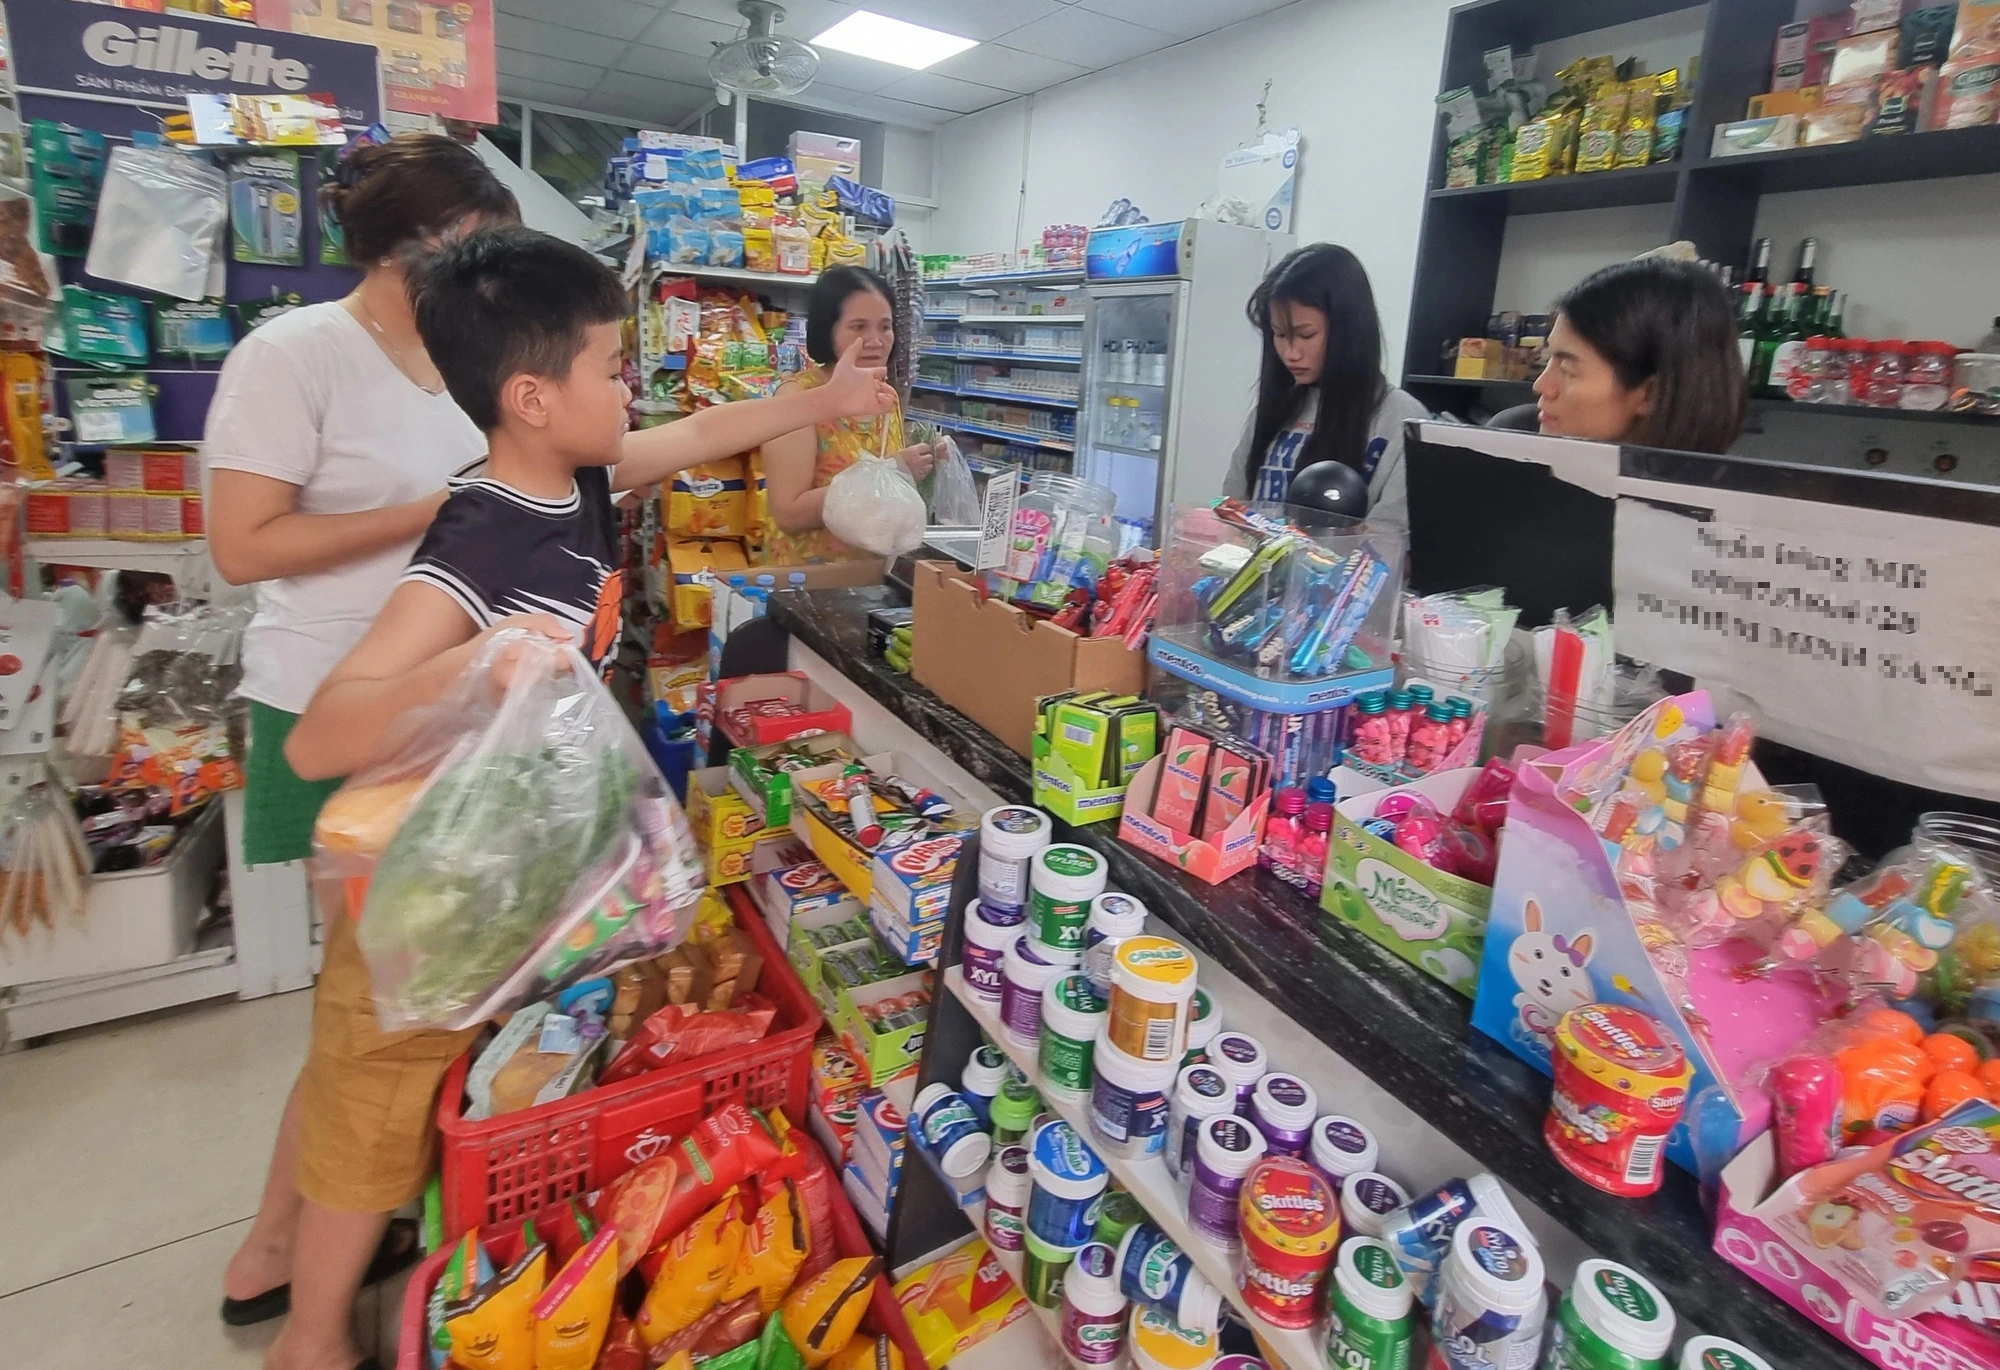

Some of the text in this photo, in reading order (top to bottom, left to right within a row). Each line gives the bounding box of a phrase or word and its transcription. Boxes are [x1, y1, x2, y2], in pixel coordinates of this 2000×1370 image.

[82, 20, 310, 91] Gillette
[1956, 66, 2000, 90] Cozy
[1582, 1011, 1645, 1058] Skittles
[1259, 1193, 1325, 1213] Skittles
[1611, 1275, 1642, 1318] XYLITOL
